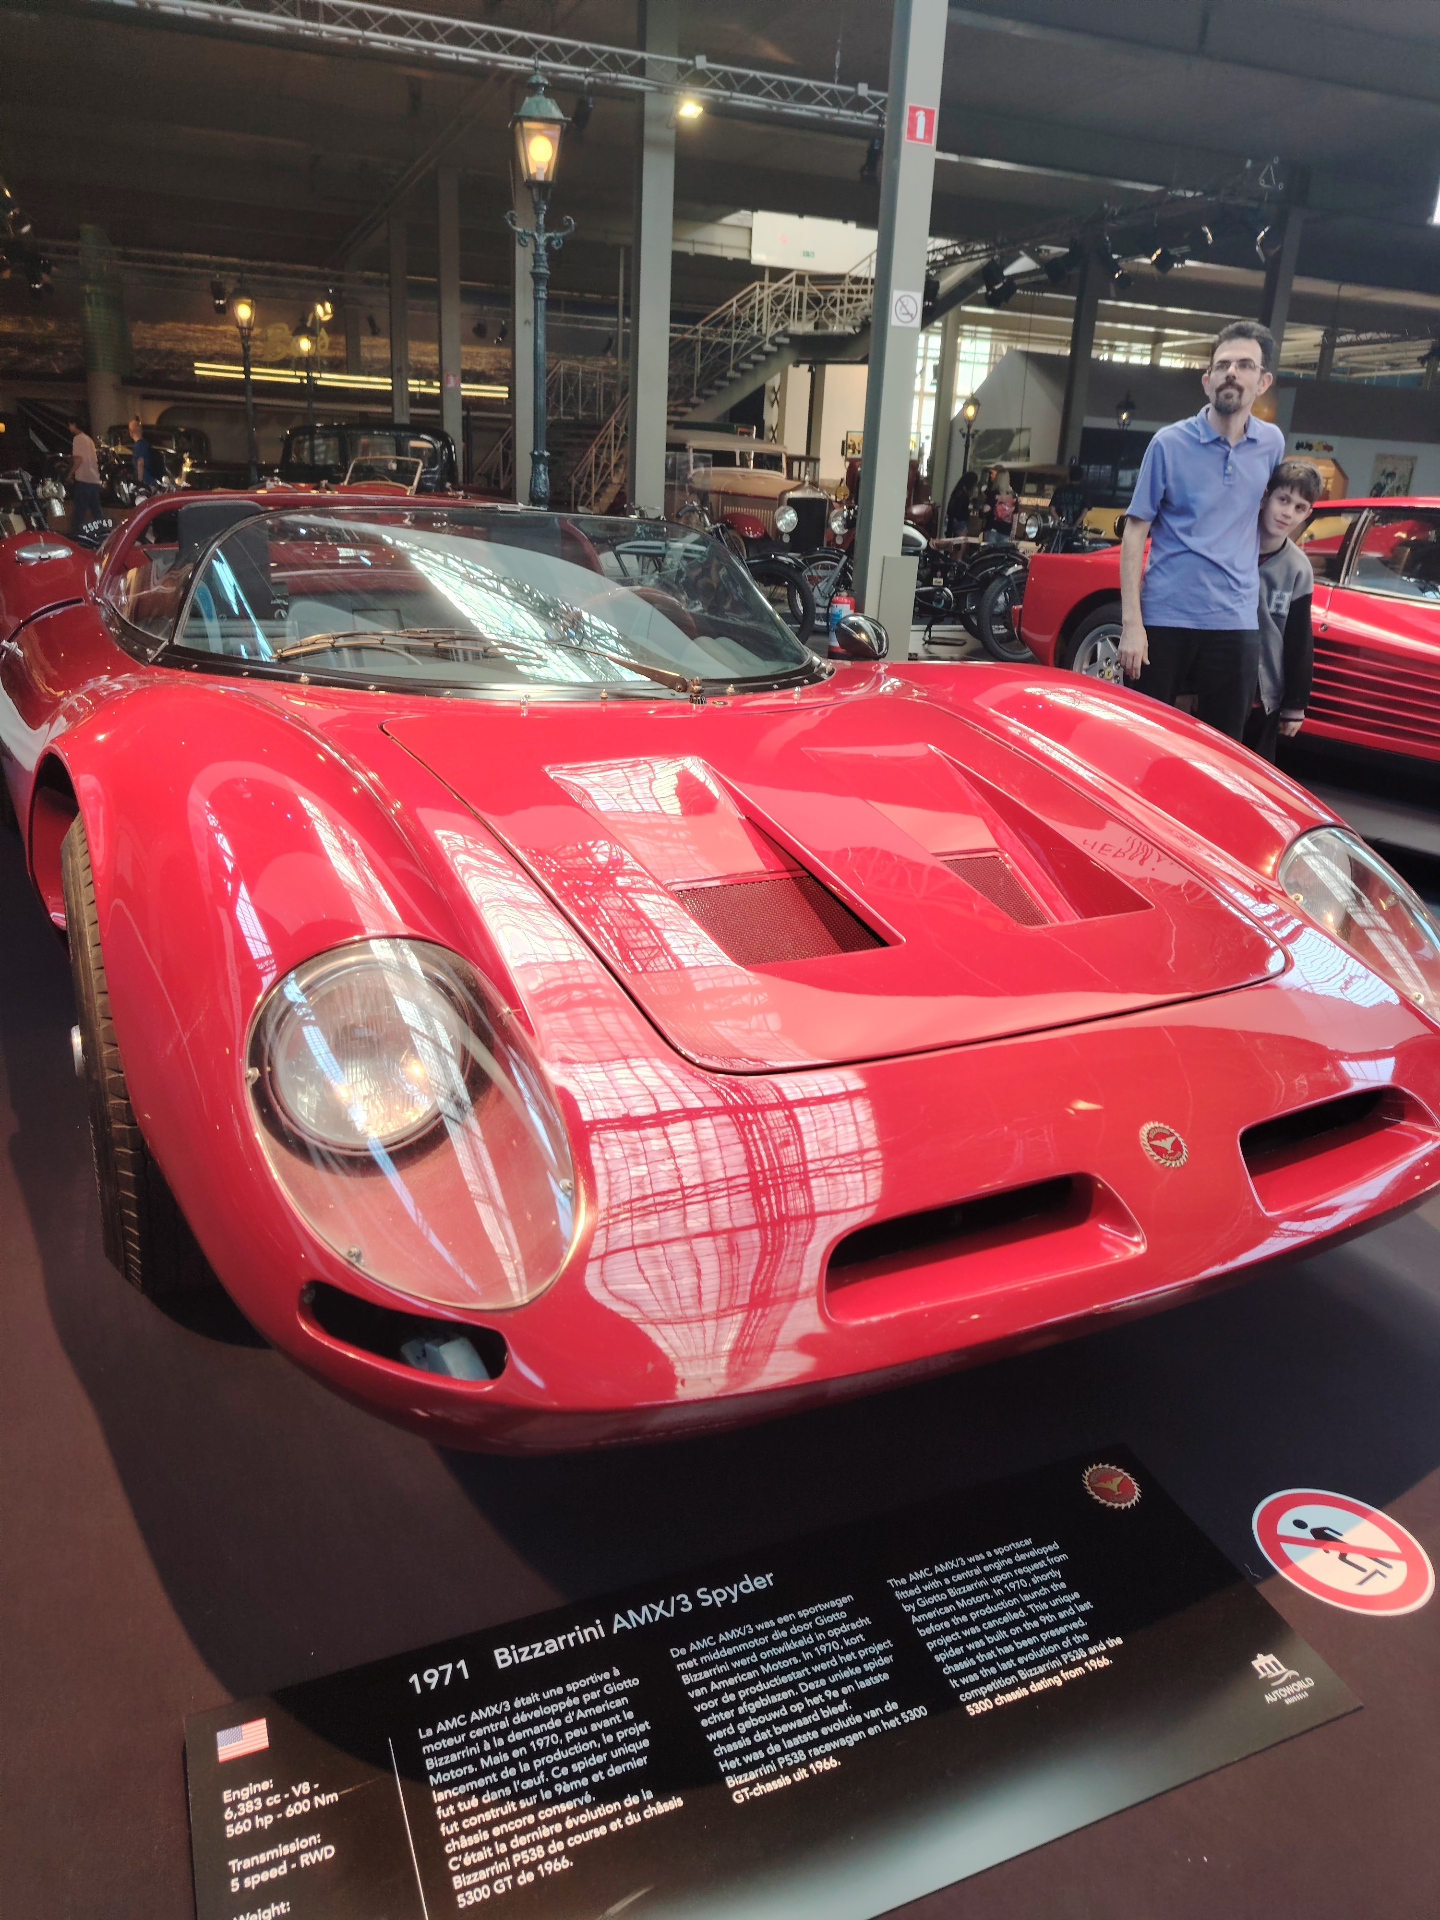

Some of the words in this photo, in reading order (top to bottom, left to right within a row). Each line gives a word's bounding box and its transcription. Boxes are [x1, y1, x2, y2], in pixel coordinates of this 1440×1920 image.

[886, 1577, 907, 1588] The
[908, 1567, 933, 1582] AMC
[933, 1556, 966, 1574] AMX/3
[966, 1552, 985, 1563] was
[992, 1537, 1032, 1556] sportscar
[894, 1583, 922, 1600] fitted
[921, 1578, 943, 1591] with
[943, 1577, 950, 1585] a
[951, 1564, 982, 1582] central
[982, 1557, 1013, 1572] engine
[1013, 1540, 1059, 1562] developed
[901, 1602, 915, 1613] by
[915, 1592, 947, 1607] Giotto
[946, 1576, 989, 1597] Bizzarrini
[989, 1571, 1013, 1584] upon
[1013, 1559, 1048, 1576] request
[1045, 1553, 1069, 1565] from
[669, 1647, 687, 1658] De
[689, 1635, 716, 1652] AMC
[718, 1623, 753, 1643] AMX/3
[754, 1619, 775, 1631] was
[776, 1612, 796, 1624] een
[796, 1594, 854, 1618] sportwagen
[911, 1603, 956, 1625] American
[954, 1592, 993, 1609] Motors.
[992, 1587, 1004, 1597] In
[1003, 1578, 1031, 1592] 1970,
[1030, 1567, 1061, 1584] shortly
[408, 1659, 470, 1695] 1971
[493, 1619, 606, 1670] Bizzarrini
[612, 1593, 693, 1635] AMX/3
[697, 1571, 775, 1609] Spyder
[675, 1657, 699, 1671] met
[699, 1634, 769, 1664] middenmotor
[771, 1628, 788, 1640] die
[789, 1620, 812, 1634] door
[814, 1610, 847, 1626] Giotto
[680, 1660, 730, 1685] Bizzarrini
[730, 1651, 758, 1668] werd
[759, 1633, 814, 1659] ontwikkeld
[813, 1631, 826, 1641] in
[826, 1616, 872, 1638] opdracht
[942, 1656, 976, 1675] chassis
[975, 1649, 997, 1663] that
[994, 1643, 1015, 1656] has
[1012, 1635, 1039, 1649] been
[1039, 1616, 1087, 1642] preserved.
[687, 1686, 708, 1698] van
[709, 1669, 760, 1692] American
[759, 1656, 801, 1674] Motors.
[800, 1650, 813, 1660] In
[813, 1640, 843, 1656] 1970,
[842, 1632, 865, 1647] kort
[693, 1697, 718, 1712] voor
[720, 1691, 736, 1703] de
[737, 1666, 811, 1701] productiestart
[810, 1655, 838, 1672] werd
[837, 1650, 857, 1664] het
[857, 1638, 893, 1660] project
[958, 1674, 1018, 1702] competition
[1016, 1656, 1062, 1680] Bizzarrini
[1060, 1647, 1087, 1664] P538
[1087, 1639, 1107, 1655] and
[1105, 1636, 1123, 1648] the
[965, 1697, 993, 1716] 5300
[993, 1686, 1029, 1706] chassis
[1028, 1674, 1062, 1693] dating
[1059, 1666, 1085, 1681] from
[1083, 1654, 1113, 1671] 1966.
[1264, 1676, 1315, 1704] AUTOWORLD
[417, 1727, 433, 1739] La
[435, 1713, 467, 1734] AMC
[469, 1700, 511, 1723] AMX/3
[513, 1692, 540, 1708] était
[541, 1686, 563, 1699] une
[565, 1671, 610, 1692] sportive
[611, 1666, 620, 1677] à
[421, 1732, 466, 1755] moteur
[468, 1715, 509, 1739] central
[511, 1696, 580, 1725] développée
[581, 1689, 601, 1705] par
[602, 1677, 639, 1694] Giotto
[712, 1735, 752, 1756] chassis
[752, 1728, 773, 1742] dat
[771, 1709, 820, 1735] bewaard
[818, 1699, 852, 1718] bleef.
[424, 1741, 480, 1770] Bizzarrini
[482, 1739, 491, 1751] à
[492, 1736, 504, 1748] la
[506, 1717, 562, 1743] demande
[428, 1763, 477, 1786] Motors.
[479, 1750, 509, 1769] Mais
[511, 1746, 527, 1758] en
[529, 1732, 562, 1751] 1970,
[564, 1725, 588, 1743] peu
[589, 1713, 622, 1732] avant
[621, 1710, 634, 1720] le
[431, 1771, 498, 1803] lancement
[499, 1765, 516, 1779] de
[517, 1761, 530, 1773] la
[532, 1739, 600, 1771] production,
[600, 1733, 613, 1744] le
[615, 1720, 651, 1742] projet
[724, 1759, 777, 1788] Bizzarrini
[776, 1749, 806, 1769] P538
[807, 1730, 866, 1758] racewagen
[866, 1724, 881, 1735] en
[880, 1715, 901, 1730] het
[899, 1704, 927, 1723] 5300
[222, 1779, 274, 1804] Engine:
[223, 1797, 262, 1821] 6,383
[265, 1794, 282, 1807] cc
[291, 1781, 311, 1798] V8
[731, 1773, 792, 1804] GT-chassis
[791, 1767, 809, 1781] uit
[808, 1755, 841, 1775] 1966.
[226, 1818, 252, 1838] 560
[255, 1812, 274, 1830] hp
[285, 1799, 311, 1818] 600
[314, 1791, 339, 1808] Nm
[451, 1856, 510, 1890] Bizzarrini
[511, 1844, 545, 1867] P538
[546, 1839, 564, 1854] de
[566, 1825, 607, 1847] course
[608, 1817, 623, 1832] et
[623, 1811, 641, 1826] du
[642, 1796, 684, 1819] châssis
[493, 1841, 507, 1855] la
[509, 1822, 562, 1849] dernière
[564, 1800, 621, 1829] évolution
[622, 1794, 640, 1808] de
[640, 1789, 653, 1801] la
[228, 1833, 322, 1874] Transmission:
[230, 1877, 240, 1893] 5
[243, 1860, 288, 1890] speed
[300, 1844, 336, 1869] RWD
[456, 1883, 490, 1908] 5300
[492, 1874, 512, 1894] GT
[516, 1870, 535, 1886] de
[536, 1855, 573, 1877] 1966.
